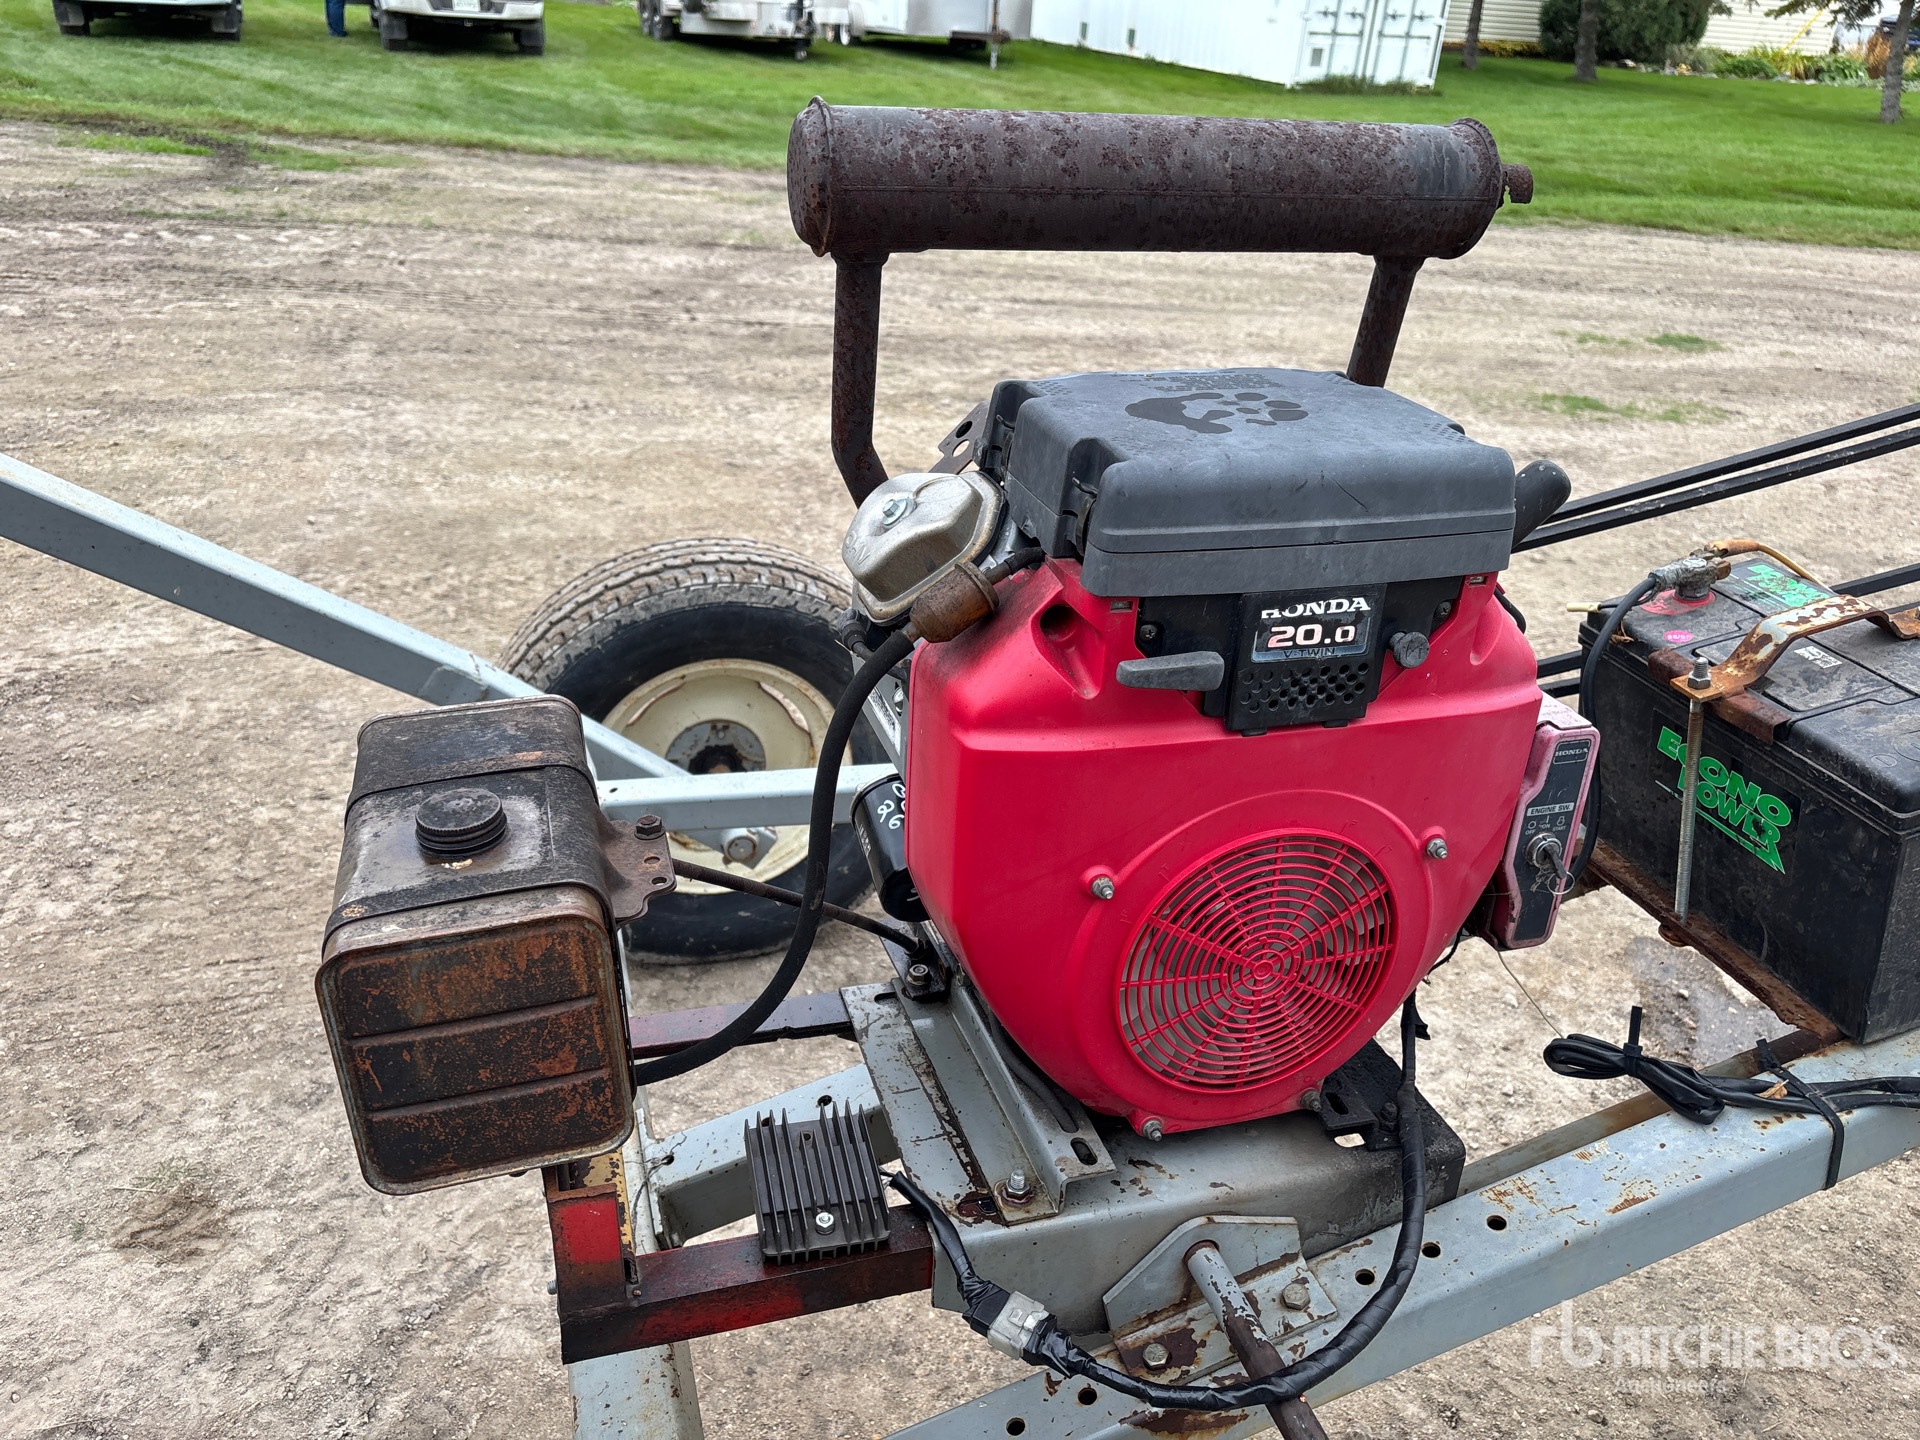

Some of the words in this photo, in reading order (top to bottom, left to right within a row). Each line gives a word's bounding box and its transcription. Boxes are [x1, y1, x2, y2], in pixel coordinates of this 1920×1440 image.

[1261, 597, 1371, 619] HONDA
[1267, 623, 1356, 648] 20.0
[1283, 647, 1336, 659] V-TWIN
[1554, 747, 1589, 757] HONDA
[1530, 806, 1556, 815] ENGINE
[1557, 804, 1571, 812] SW.
[1677, 765, 1785, 872] OWER
